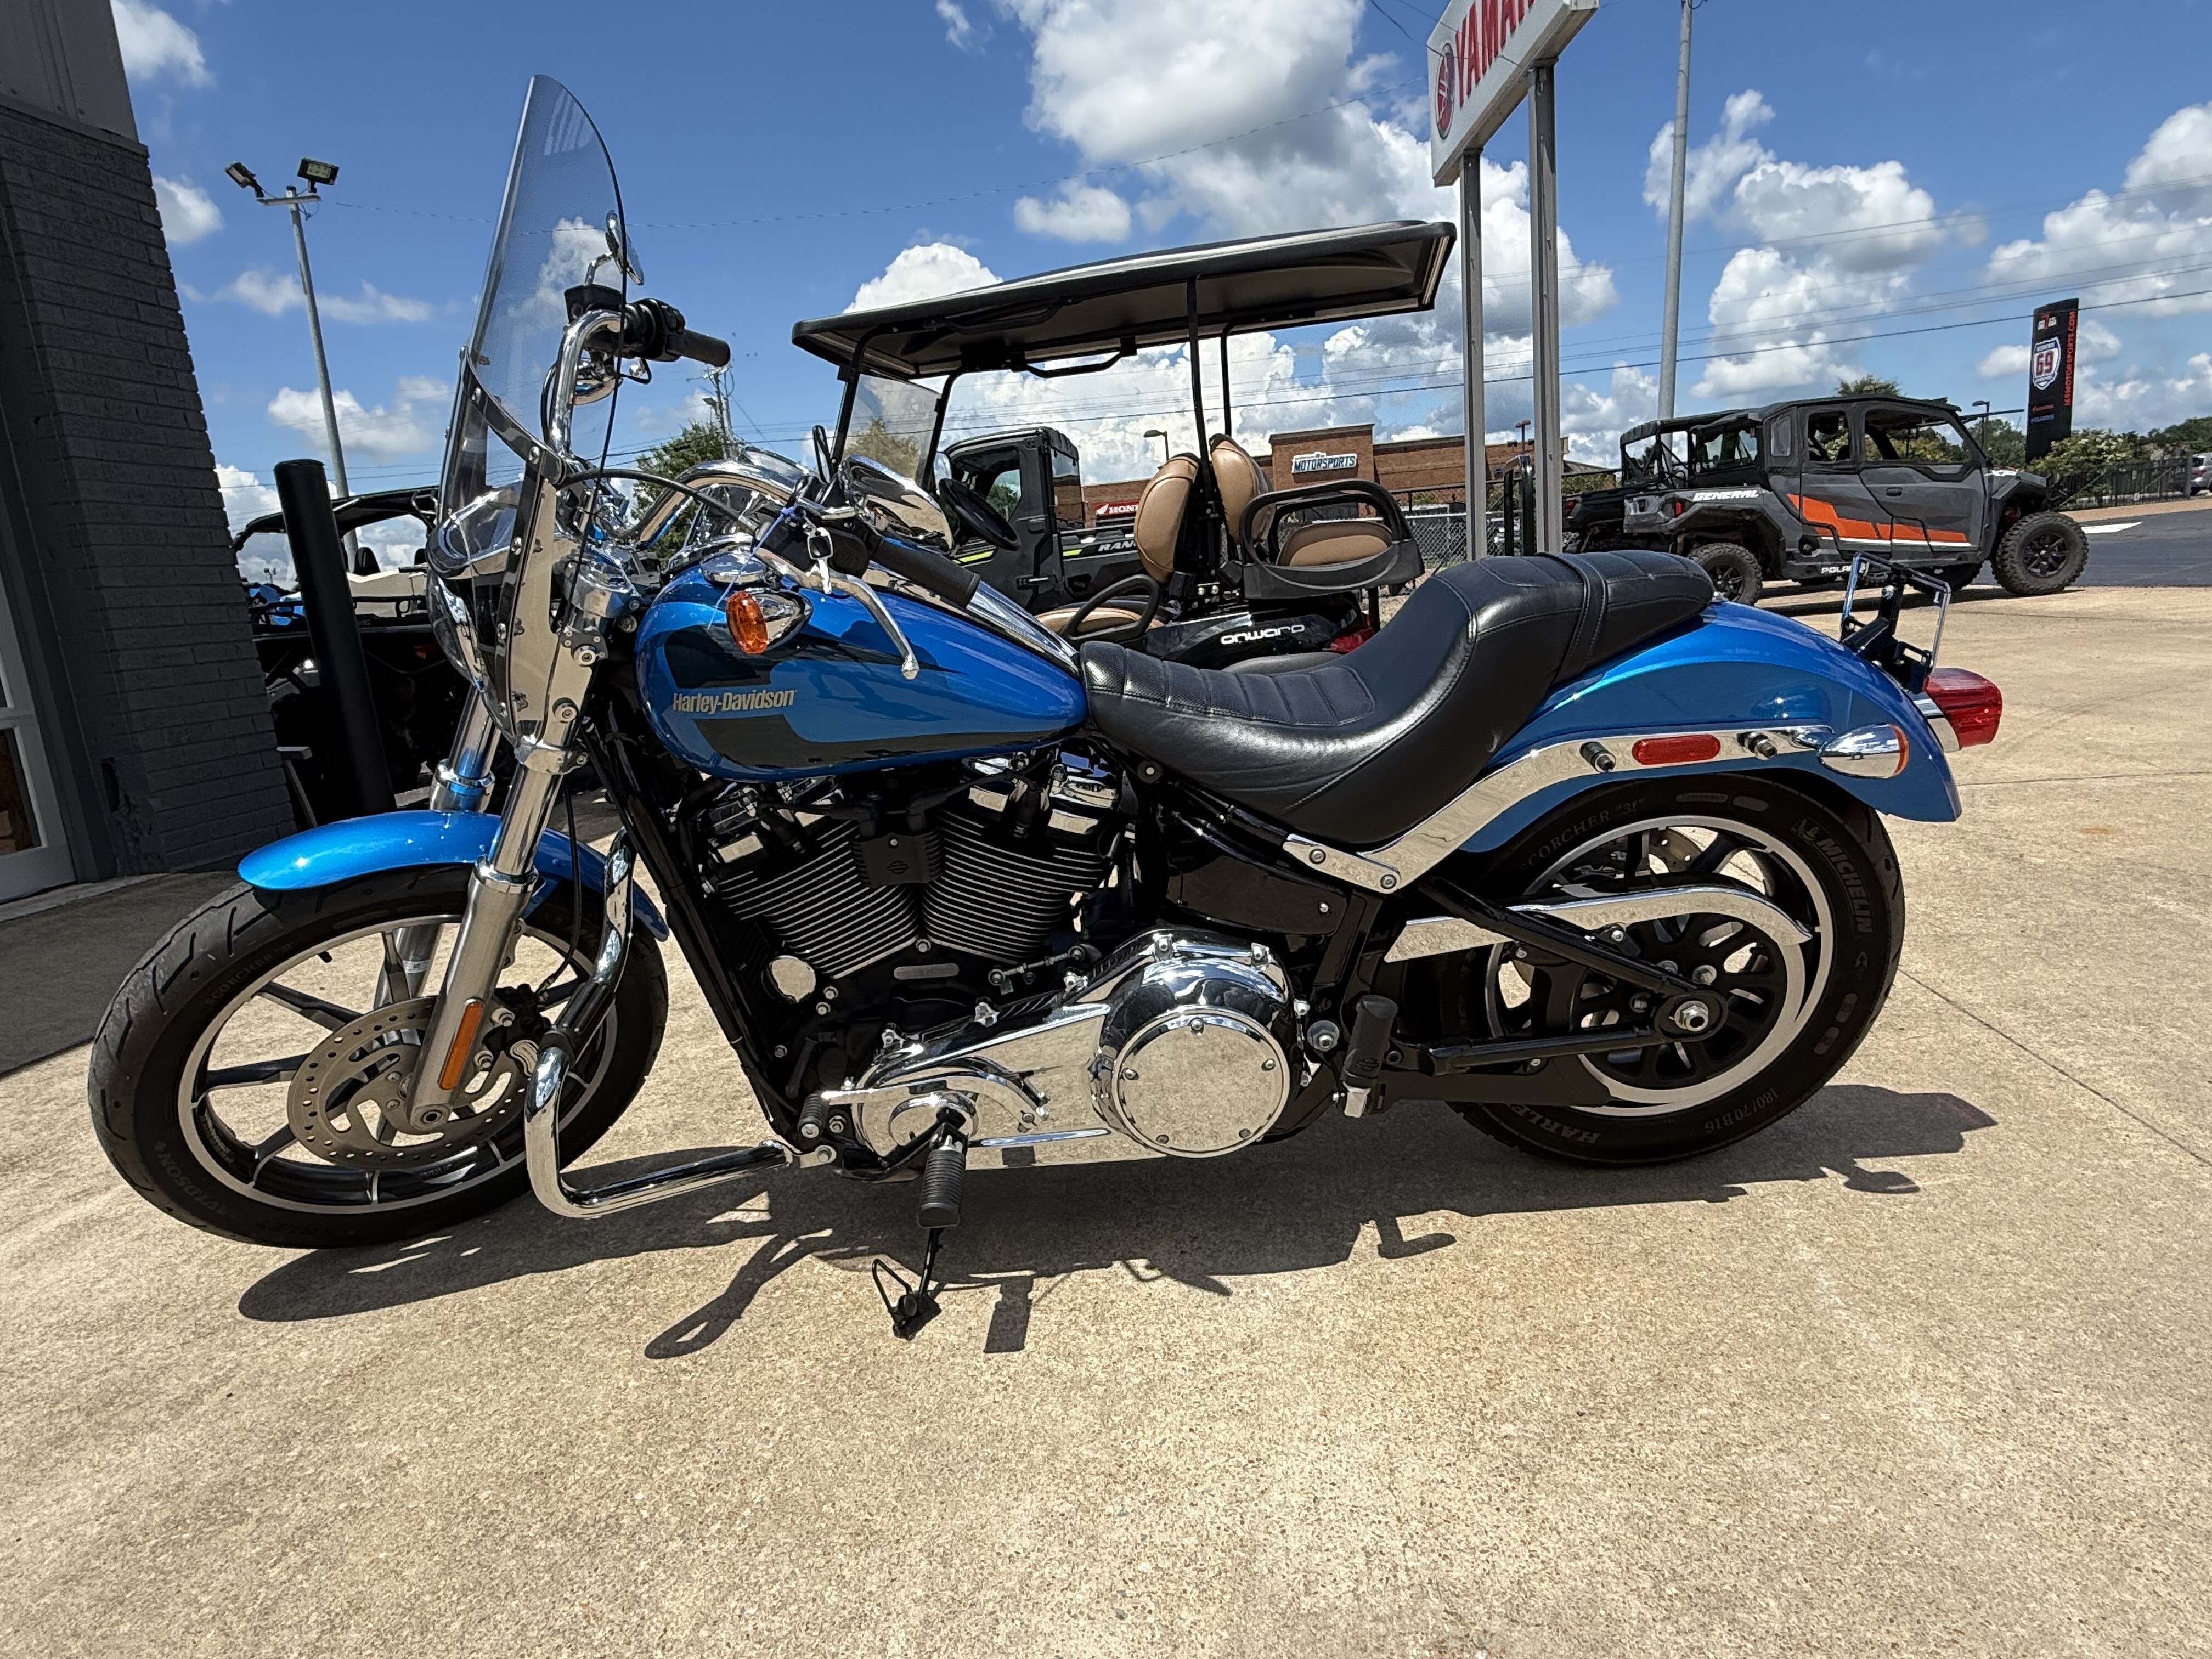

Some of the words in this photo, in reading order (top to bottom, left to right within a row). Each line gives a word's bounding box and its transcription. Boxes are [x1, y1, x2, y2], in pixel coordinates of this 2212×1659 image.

[2035, 350, 2055, 376] 69
[1294, 455, 1356, 471] MOTORSPORTS
[1692, 489, 1759, 501] GENERAL
[1108, 505, 1139, 514] HON
[1097, 540, 1137, 552] RAN
[673, 689, 795, 714] Harley-Davidson
[1816, 838, 1874, 934] MICHELIN
[1510, 1103, 1602, 1144] HARLE
